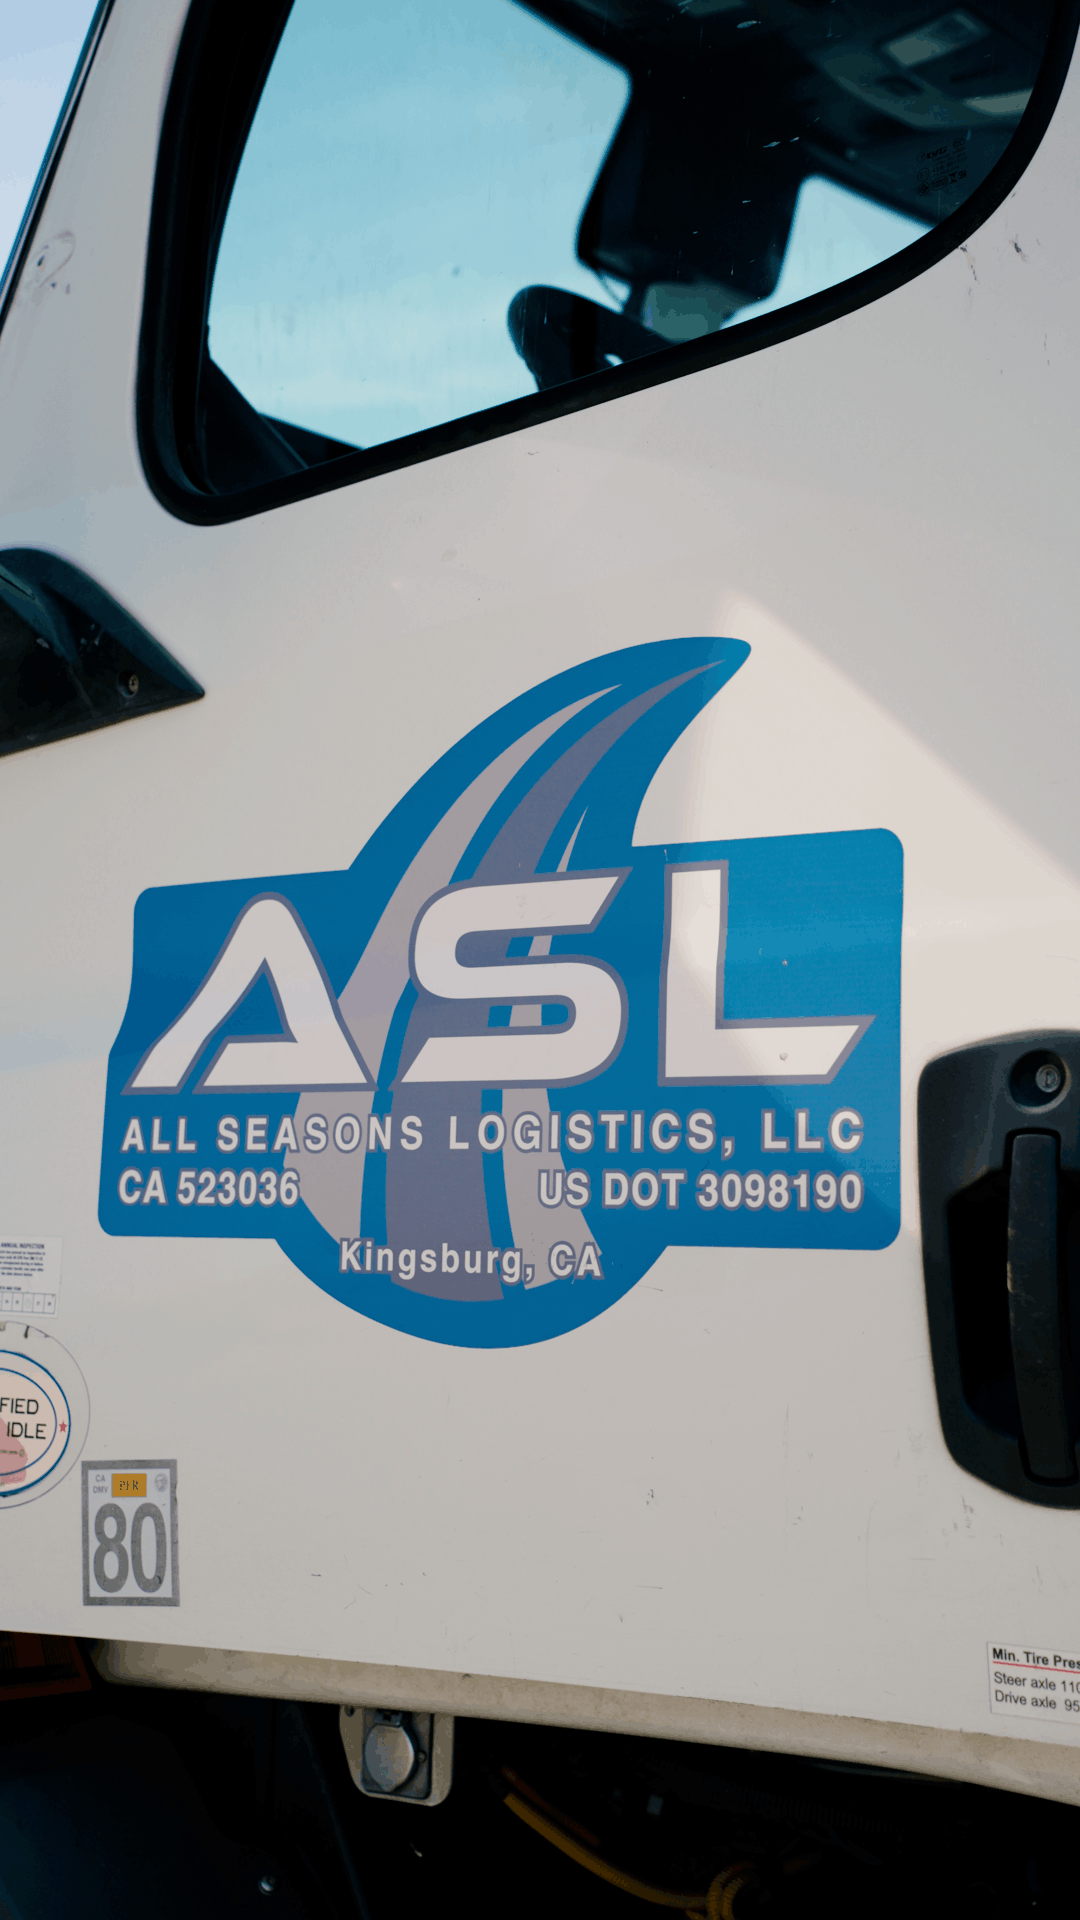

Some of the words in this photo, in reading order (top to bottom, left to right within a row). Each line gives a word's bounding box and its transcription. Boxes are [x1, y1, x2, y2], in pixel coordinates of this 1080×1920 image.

[122, 861, 876, 1095] ASL
[120, 1117, 197, 1152] ALL
[217, 1114, 424, 1153] SEASONS
[448, 1111, 734, 1159] LOGISTICS,
[762, 1109, 863, 1152] LLC
[118, 1168, 168, 1205] CA
[176, 1168, 300, 1206] 523036
[538, 1169, 591, 1208] US
[603, 1169, 687, 1209] DOT
[696, 1170, 864, 1212] 3098190
[340, 1238, 534, 1284] Kingsburg,
[549, 1241, 604, 1280] CA
[0, 1397, 39, 1415] FIED
[7, 1421, 47, 1440] IDLE
[95, 1474, 106, 1482] CA
[93, 1485, 108, 1493] DMV
[93, 1503, 167, 1593] 80
[992, 1647, 1019, 1662] Min.
[1023, 1650, 1049, 1665] Tire
[994, 1671, 1027, 1687] Steer
[1030, 1677, 1056, 1691] axle
[995, 1689, 1027, 1706] Drive
[1031, 1696, 1057, 1709] axle
[1064, 1699, 1080, 1712] 95
